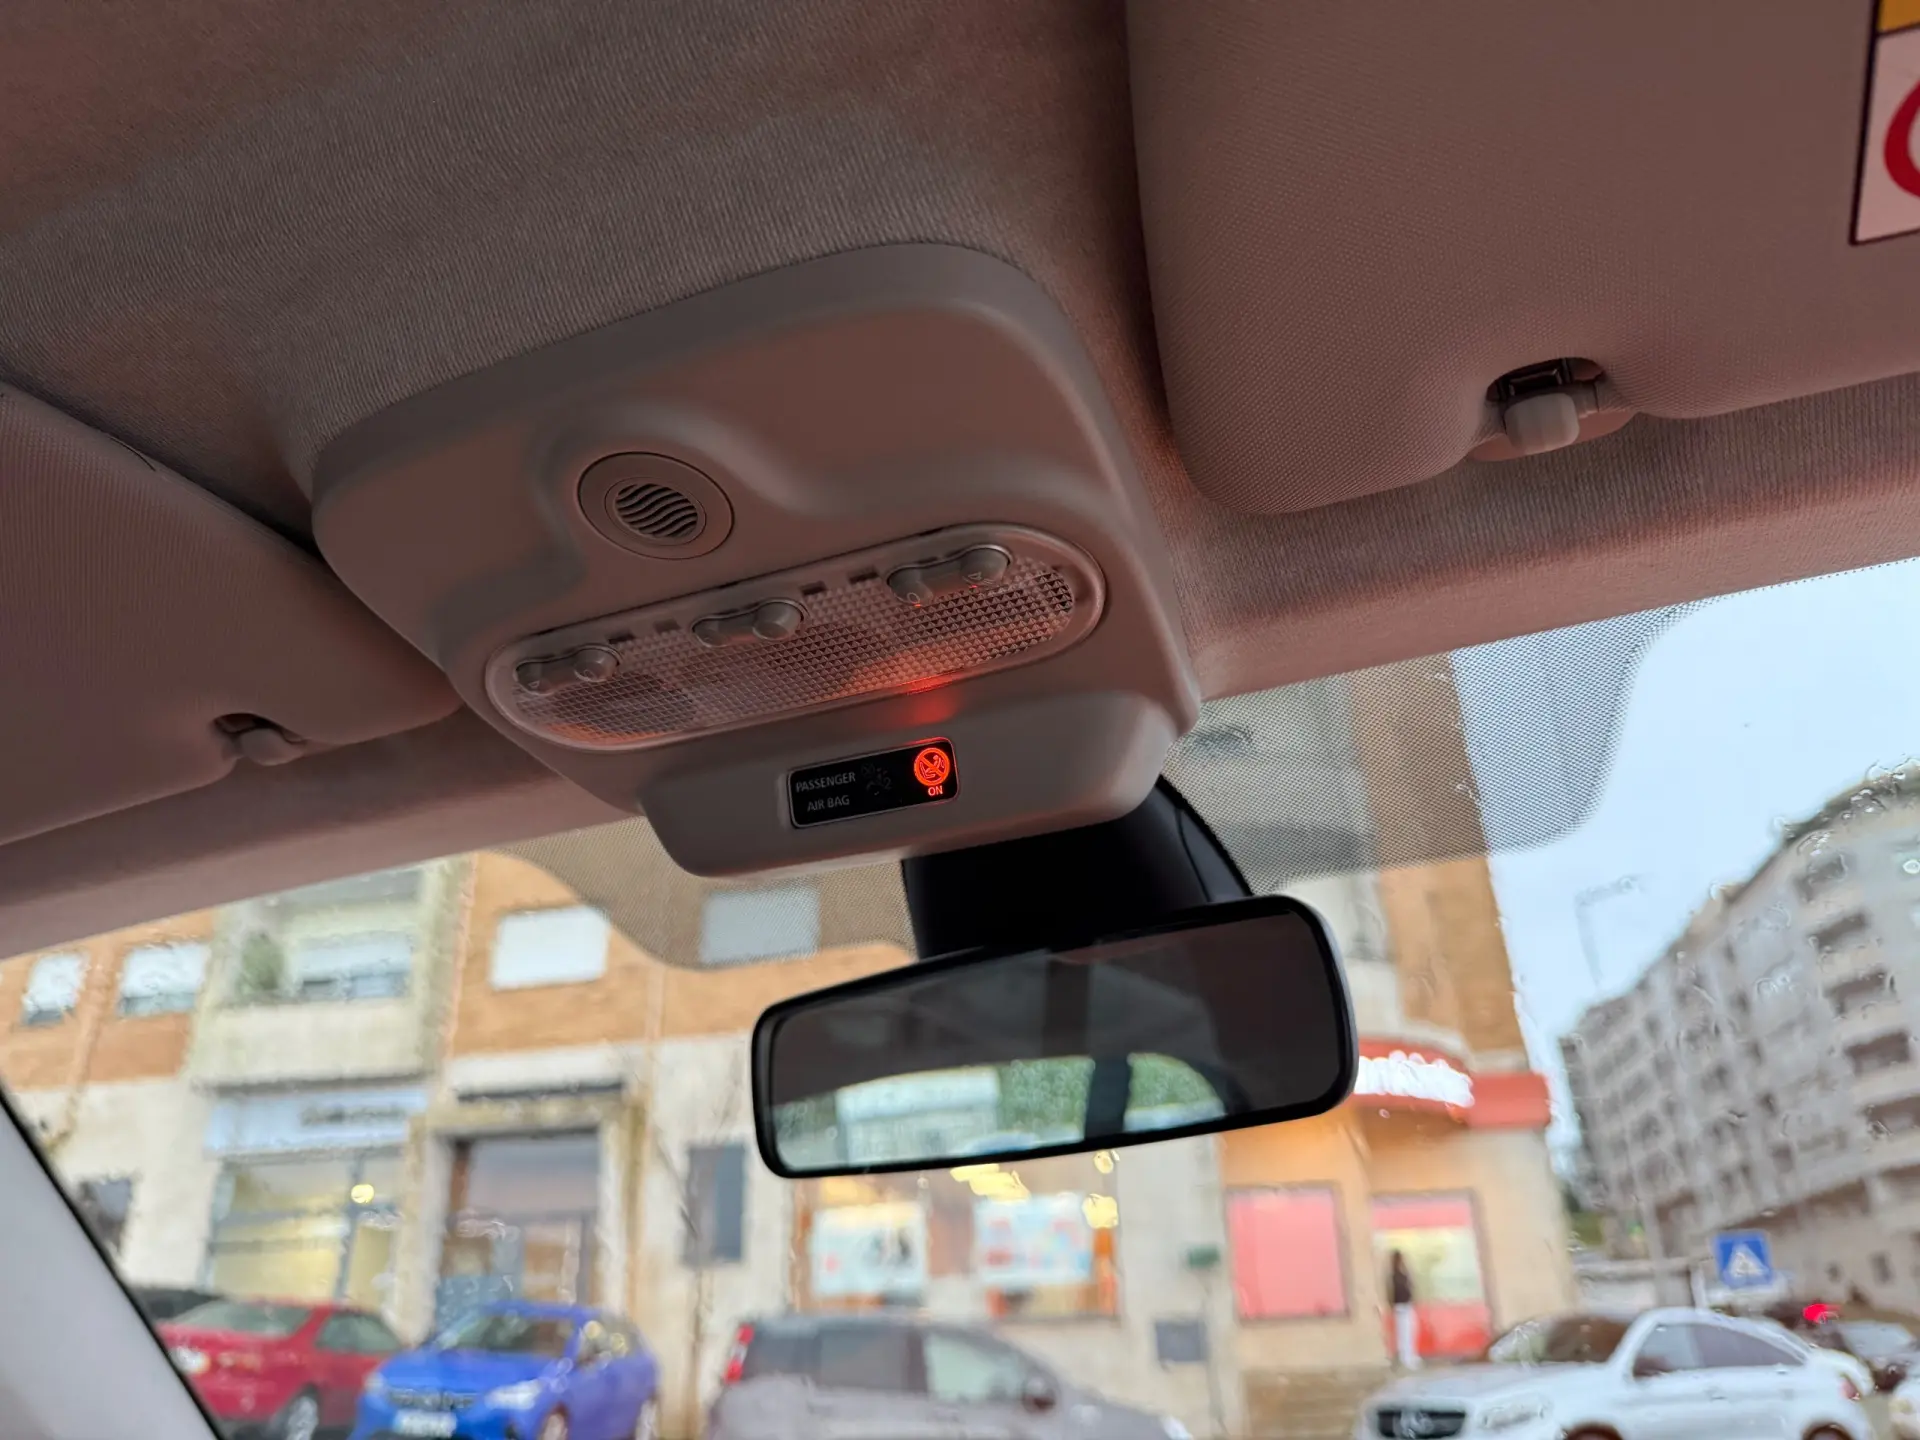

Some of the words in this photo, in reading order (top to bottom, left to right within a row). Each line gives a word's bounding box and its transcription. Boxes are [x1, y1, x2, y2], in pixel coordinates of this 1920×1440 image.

[795, 771, 856, 793] PASSENGER
[927, 785, 943, 797] ON
[807, 798, 825, 812] AIR
[827, 794, 851, 809] BAG
